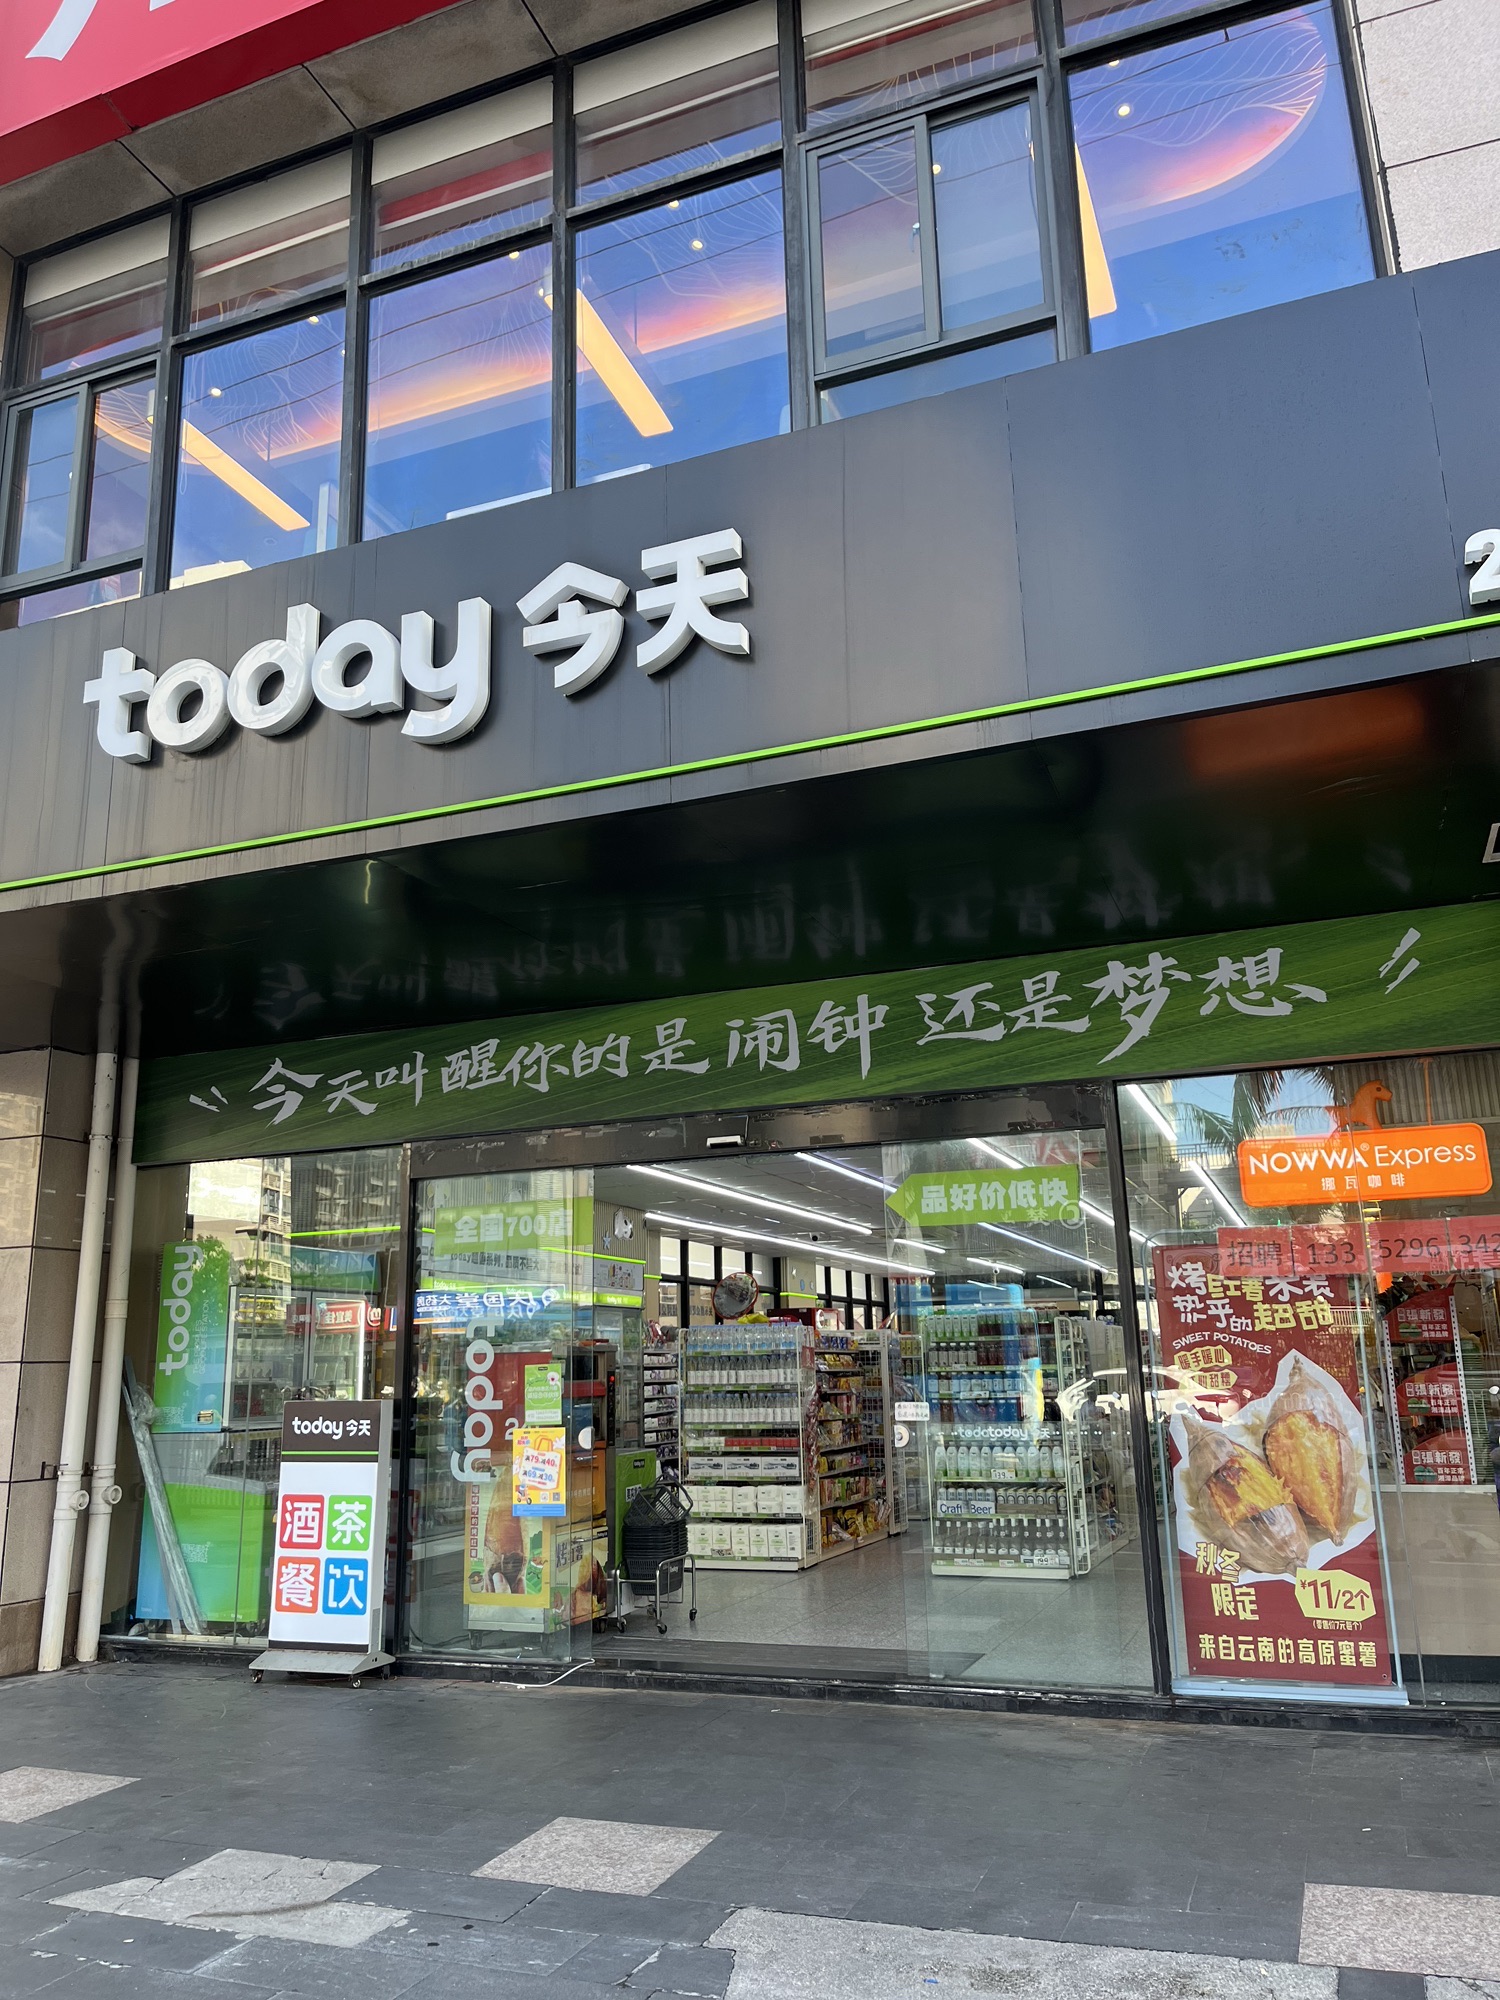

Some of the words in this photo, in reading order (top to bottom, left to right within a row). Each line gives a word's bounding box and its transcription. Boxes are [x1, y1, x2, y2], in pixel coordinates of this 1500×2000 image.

[83, 597, 491, 763] today
[516, 527, 750, 697] 今天
[1375, 1143, 1477, 1169] Express
[921, 1177, 1068, 1214] 品好价低快
[1322, 1173, 1405, 1191] 挪瓦咖啡
[454, 1209, 573, 1244] 全国700店
[1228, 1241, 1282, 1267] 招聘
[1308, 1242, 1356, 1266] 133
[1379, 1237, 1442, 1260] 5296
[159, 1245, 204, 1376] today
[1172, 1331, 1211, 1350] SWEET
[1213, 1332, 1272, 1354] POTATOES
[1191, 1371, 1231, 1388] 心甜糯
[451, 1317, 503, 1482] today
[292, 1415, 344, 1440] today
[345, 1418, 371, 1437] 今天
[282, 1500, 321, 1544] 酒
[332, 1500, 366, 1544] 茶
[971, 1503, 993, 1514] Beer
[1195, 1542, 1241, 1583] 秋冬
[279, 1562, 315, 1607] 餐
[328, 1564, 364, 1610] 饮
[1211, 1583, 1259, 1621] 限定
[1199, 1633, 1377, 1667] 来自云南的高原蜜薯
